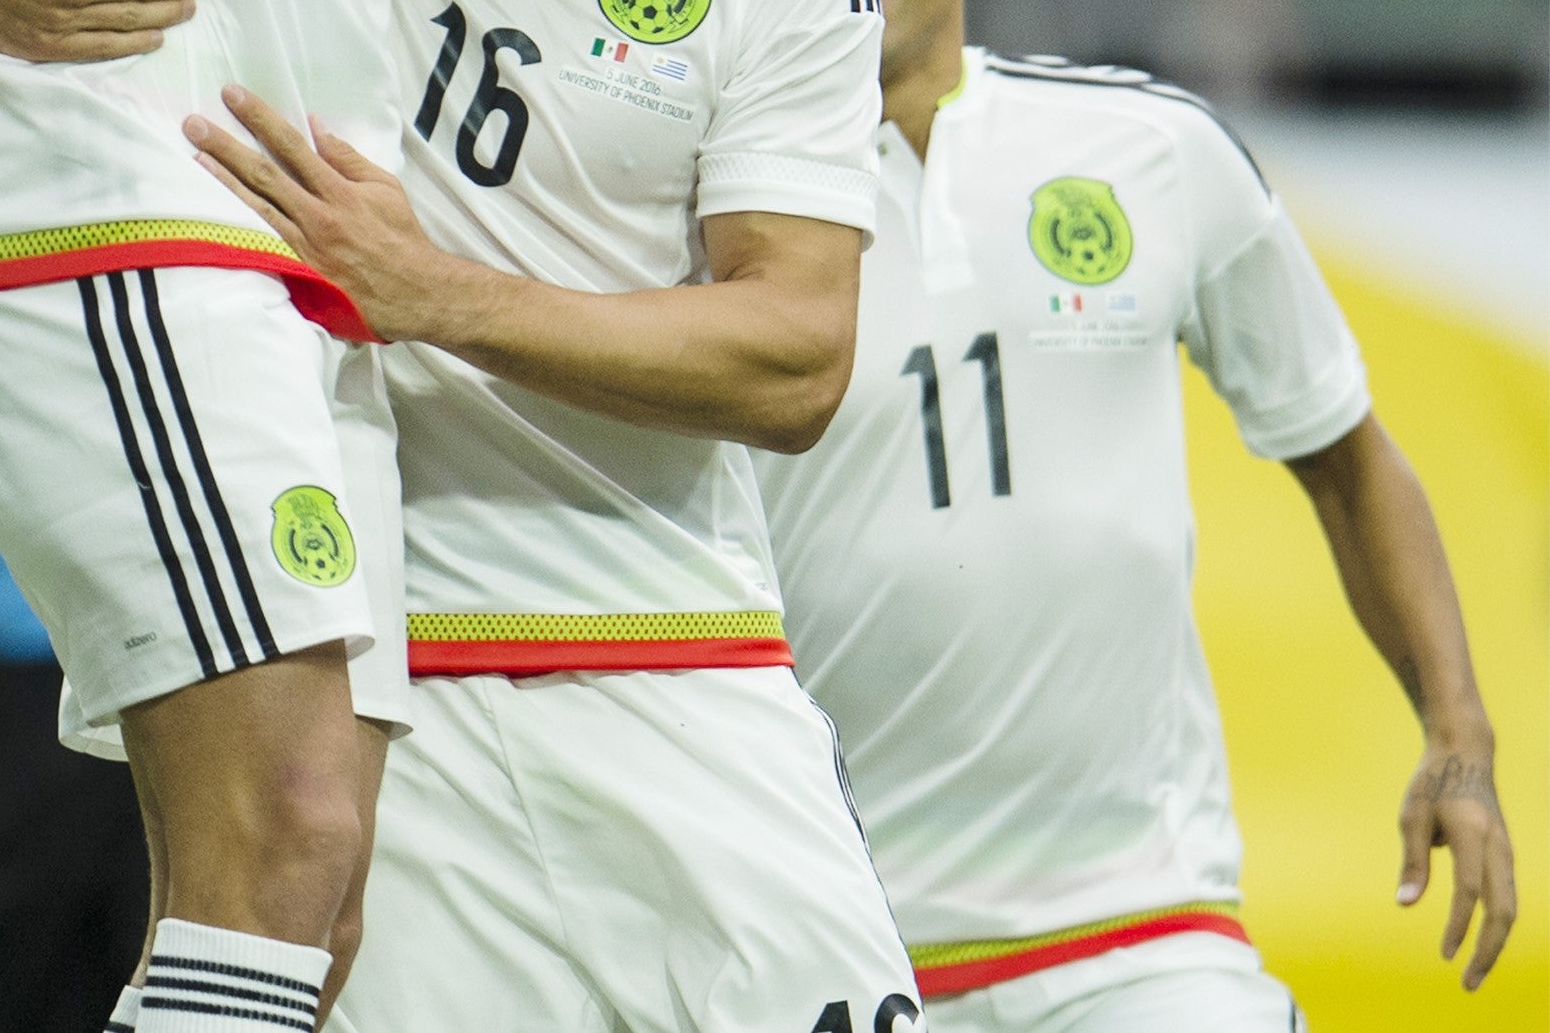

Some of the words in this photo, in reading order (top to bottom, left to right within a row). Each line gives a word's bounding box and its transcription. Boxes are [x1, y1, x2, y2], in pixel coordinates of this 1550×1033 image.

[413, 0, 543, 188] 16
[558, 70, 610, 94] UNIVERSITY
[610, 86, 624, 99] OF
[623, 90, 661, 111] PHOENIX
[661, 103, 694, 121] STADIUM
[615, 71, 639, 89] JUNE
[639, 79, 662, 96] 2016
[900, 331, 1012, 511] 11
